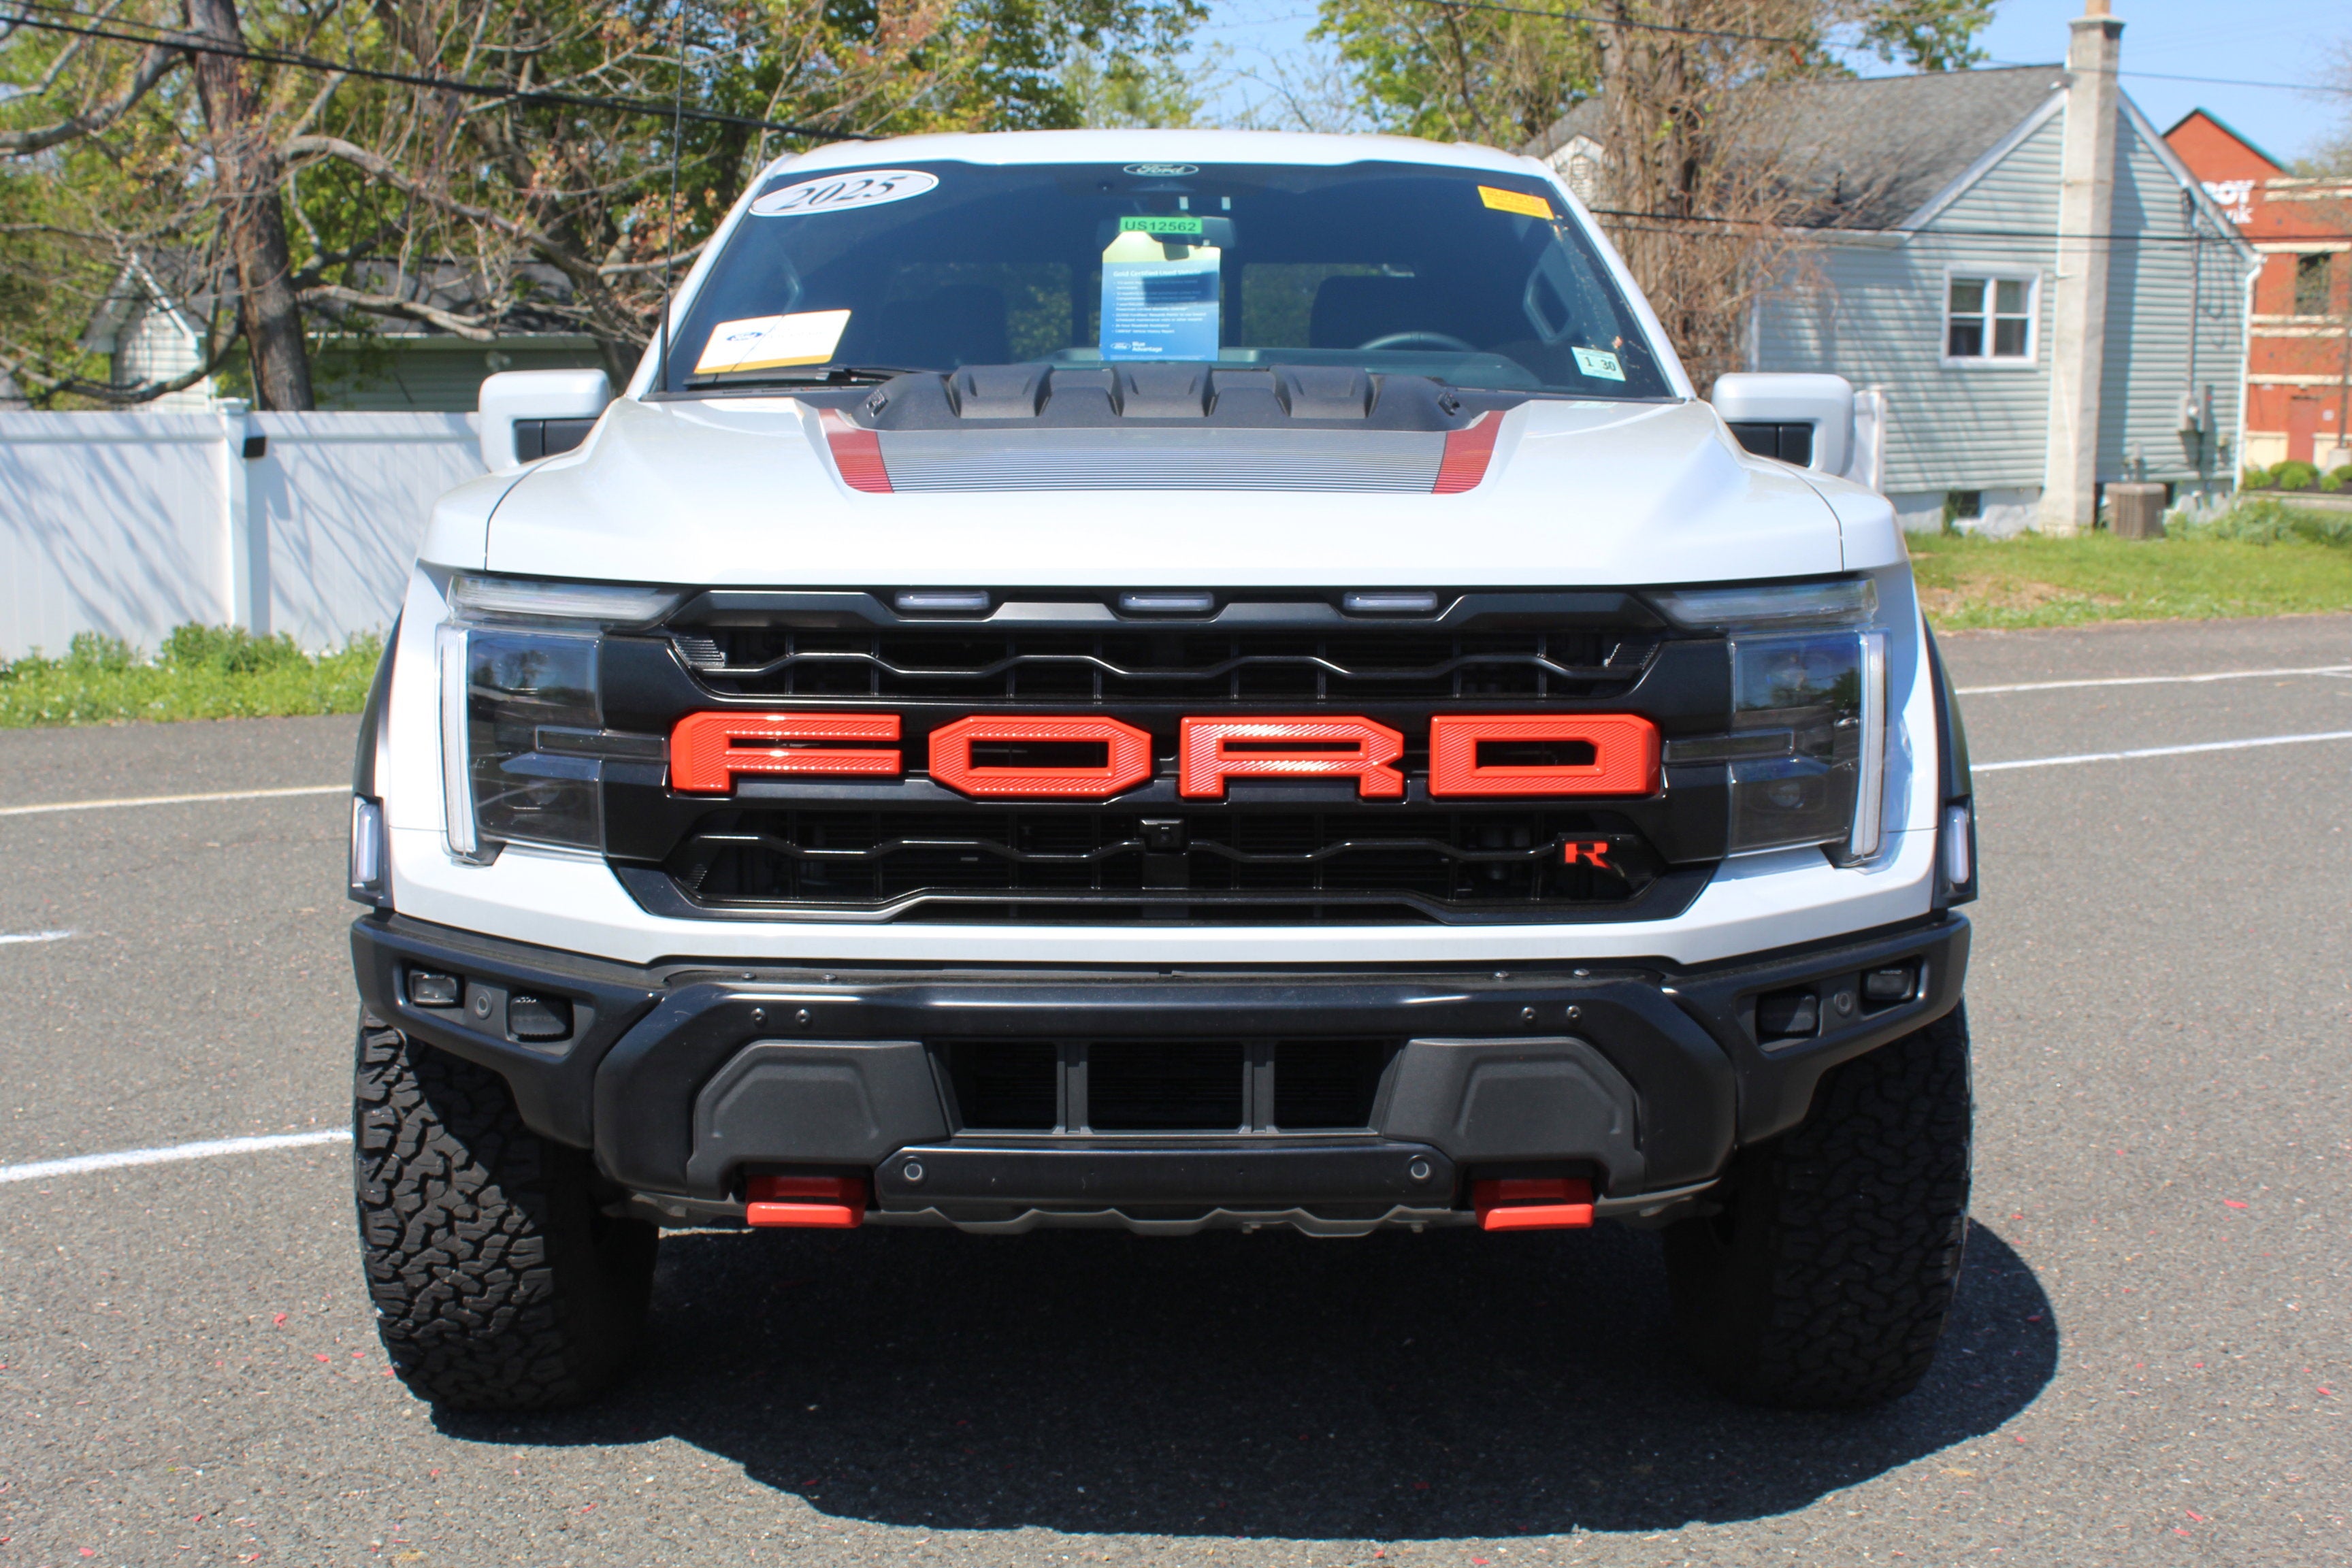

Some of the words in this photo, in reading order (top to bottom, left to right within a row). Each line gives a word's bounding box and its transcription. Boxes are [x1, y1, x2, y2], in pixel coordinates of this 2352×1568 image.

[774, 176, 908, 210] 2025
[1125, 221, 1196, 231] US12562
[1584, 357, 1594, 367] 1
[1601, 359, 1617, 372] 30
[671, 711, 1660, 798] FORD
